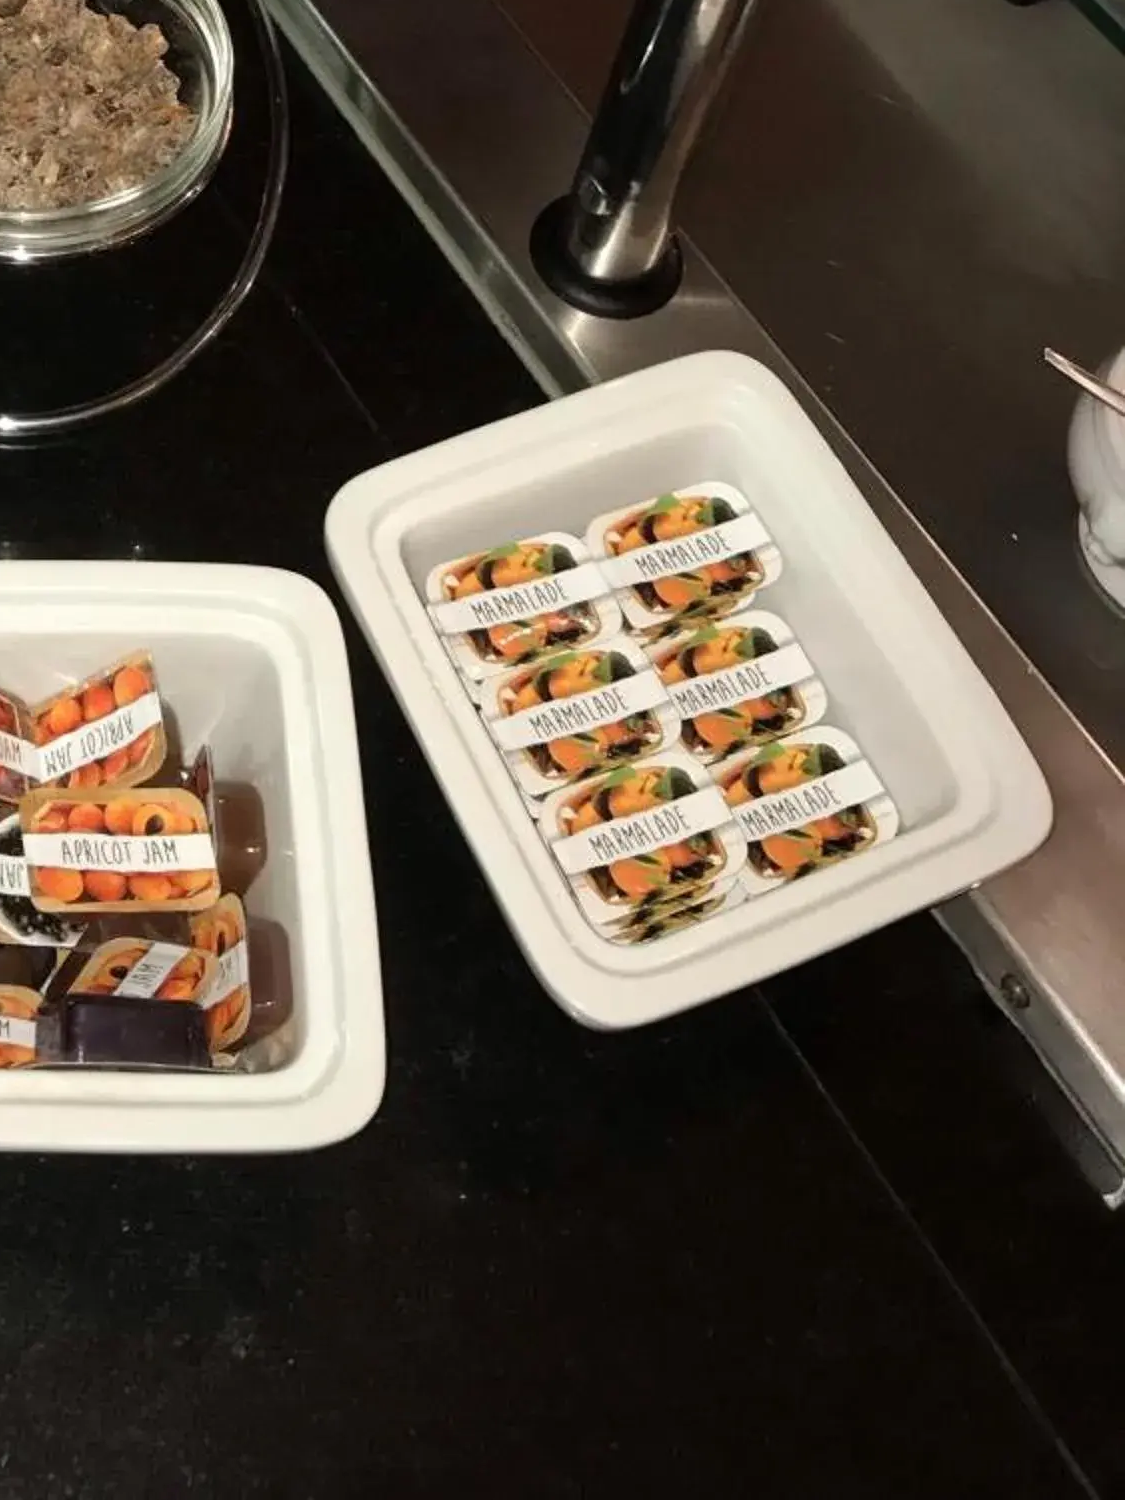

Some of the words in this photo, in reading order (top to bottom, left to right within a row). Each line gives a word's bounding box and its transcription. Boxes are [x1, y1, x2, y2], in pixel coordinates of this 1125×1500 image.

[635, 530, 732, 576] MARMALADE
[470, 577, 567, 625] MARMALADE
[675, 663, 773, 713] MARMALADE
[81, 710, 133, 758] APRICOT
[529, 688, 629, 738] MARMALADE
[43, 742, 72, 774] JAM
[589, 805, 691, 859] MARMALADE
[741, 781, 841, 835] MARMALADE
[62, 840, 132, 865] APRICOT
[143, 840, 180, 865] JAM
